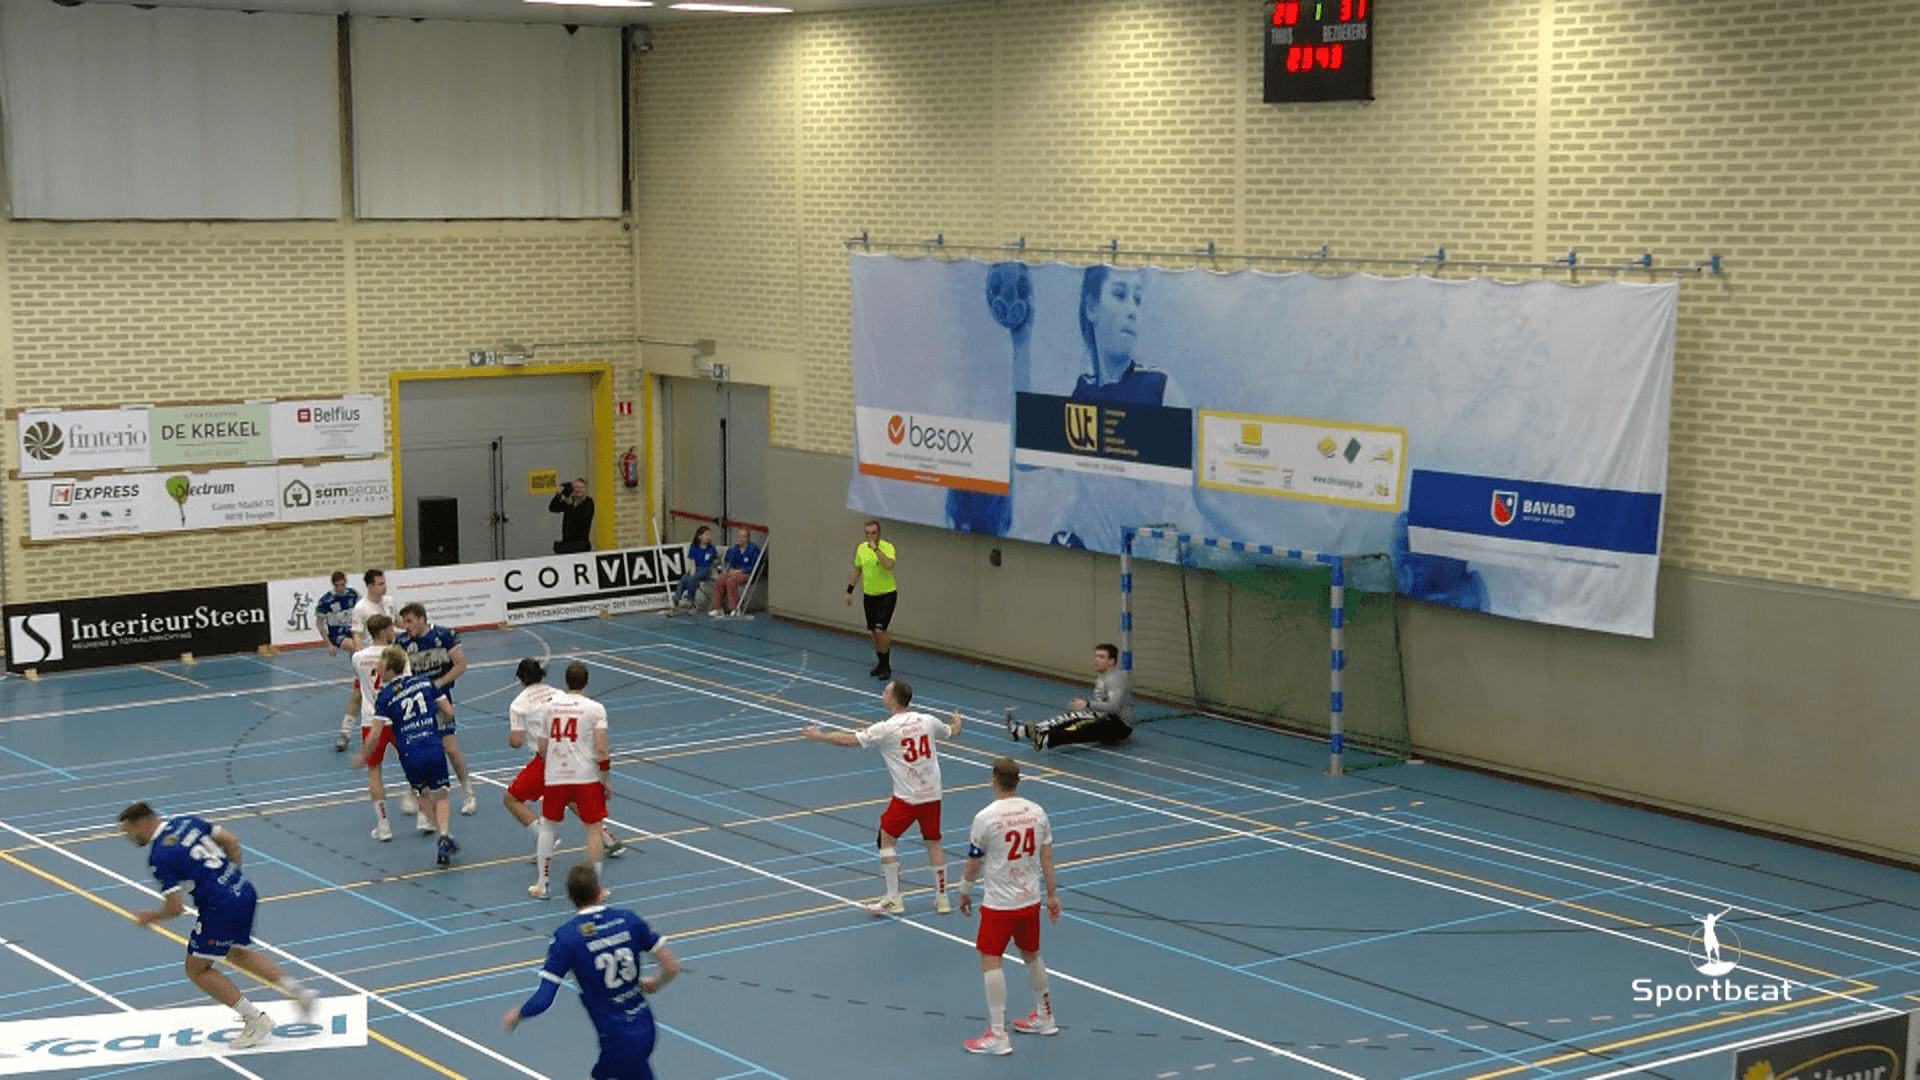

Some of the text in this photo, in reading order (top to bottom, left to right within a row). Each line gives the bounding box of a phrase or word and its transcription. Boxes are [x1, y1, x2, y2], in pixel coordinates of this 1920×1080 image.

[1322, 23, 1367, 41] BEZOEKERS
[313, 406, 361, 423] Belfius
[69, 424, 147, 448] finterio
[161, 421, 260, 440] DE KREKEL
[909, 415, 974, 454] besox
[74, 484, 139, 501] EXPRESS
[315, 485, 388, 499] samseaux
[1522, 499, 1576, 519] BAYARD
[504, 552, 683, 592] CORVAN
[71, 605, 266, 641] InterieurSteen
[508, 612, 524, 620] van
[401, 691, 428, 720] 21
[550, 717, 578, 742] 44
[901, 734, 931, 763] 34
[1004, 827, 1036, 861] 24
[594, 947, 638, 989] 23
